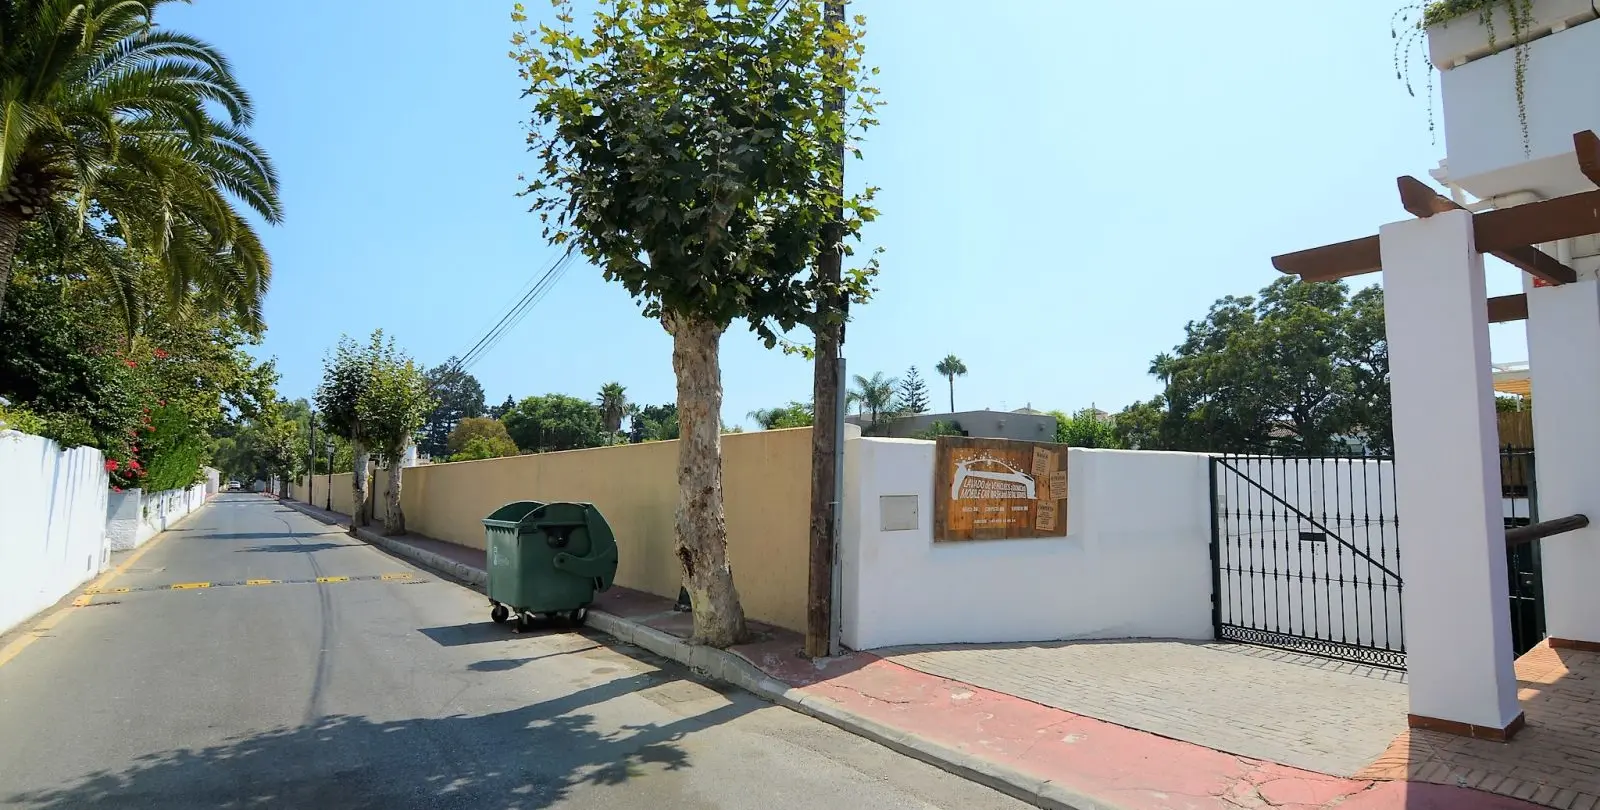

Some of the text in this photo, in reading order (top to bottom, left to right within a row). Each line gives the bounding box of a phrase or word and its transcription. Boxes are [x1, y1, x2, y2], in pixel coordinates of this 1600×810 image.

[963, 478, 985, 489] LAVADO
[959, 488, 981, 498] MOBILE
[981, 489, 990, 498] CAR
